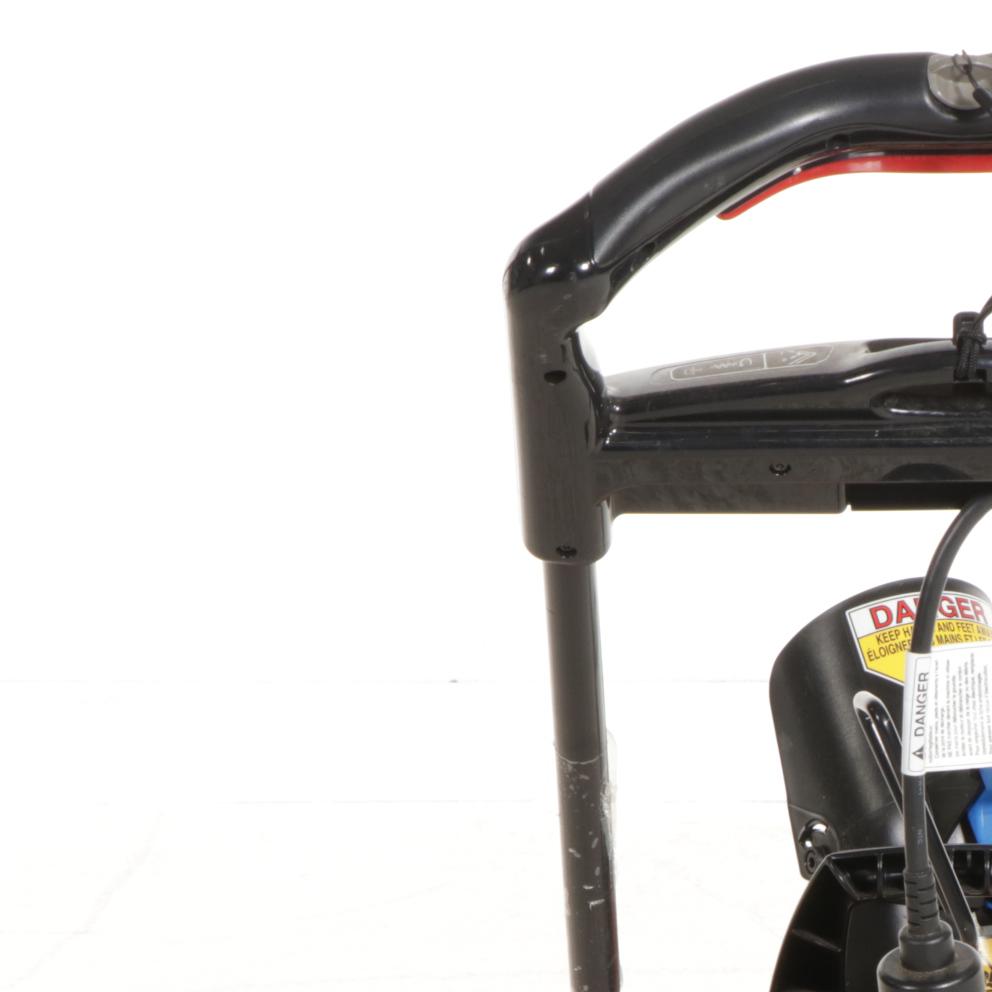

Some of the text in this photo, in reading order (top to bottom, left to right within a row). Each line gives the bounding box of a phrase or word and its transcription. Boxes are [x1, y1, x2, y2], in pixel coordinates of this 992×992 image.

[869, 595, 988, 630] DAGER
[875, 629, 901, 646] KEEP
[937, 621, 955, 633] AND
[956, 622, 974, 633] FEET
[935, 634, 962, 645] MAINS
[914, 672, 929, 738] DANGER
